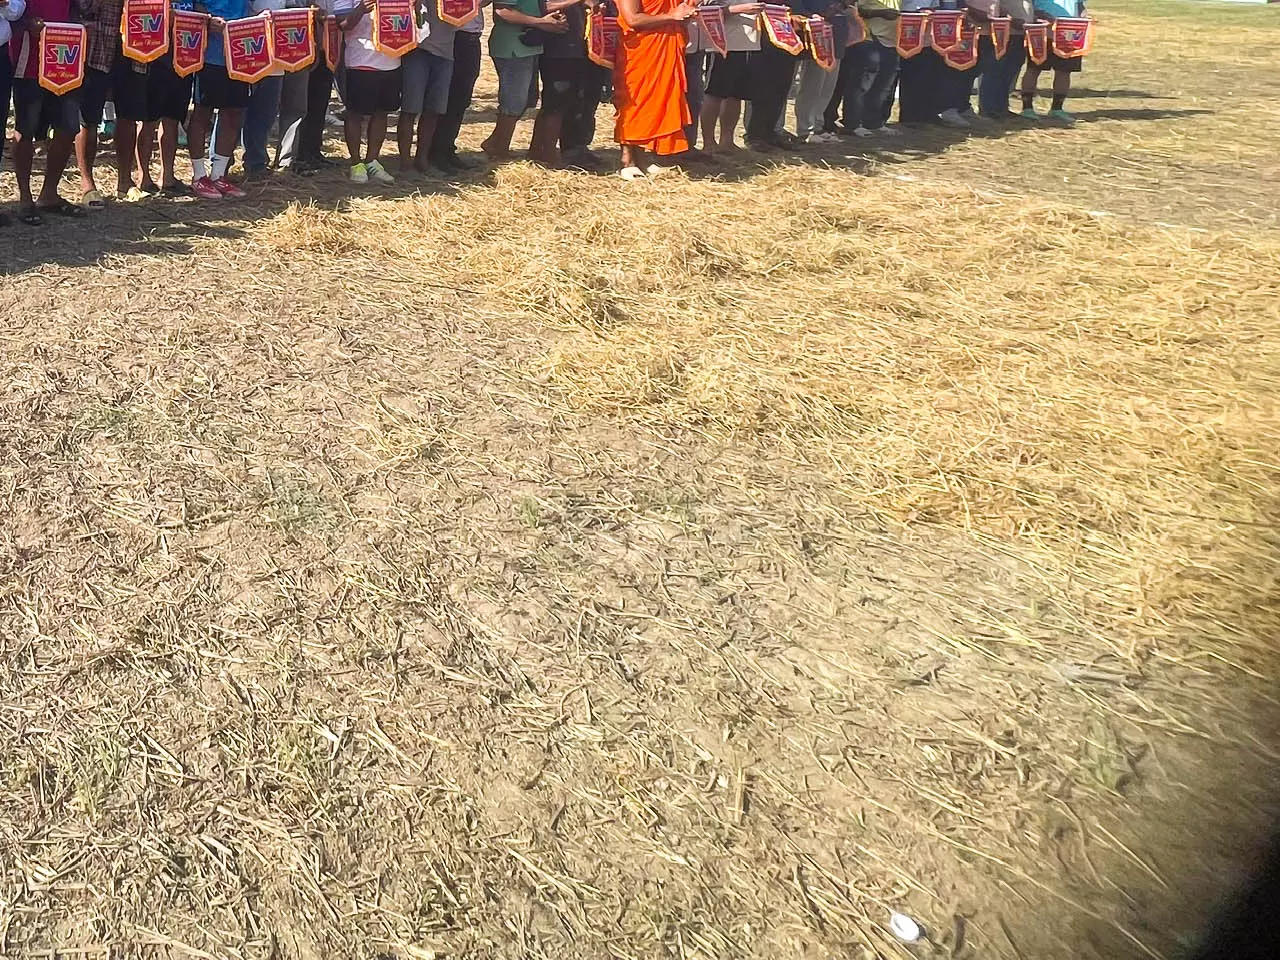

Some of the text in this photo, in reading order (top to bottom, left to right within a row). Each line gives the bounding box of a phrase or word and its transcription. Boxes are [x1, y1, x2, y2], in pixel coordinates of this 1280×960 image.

[129, 13, 163, 34] STV
[380, 14, 410, 32] STV
[231, 34, 265, 58] STV
[276, 26, 307, 46] STV
[46, 43, 80, 65] STV
